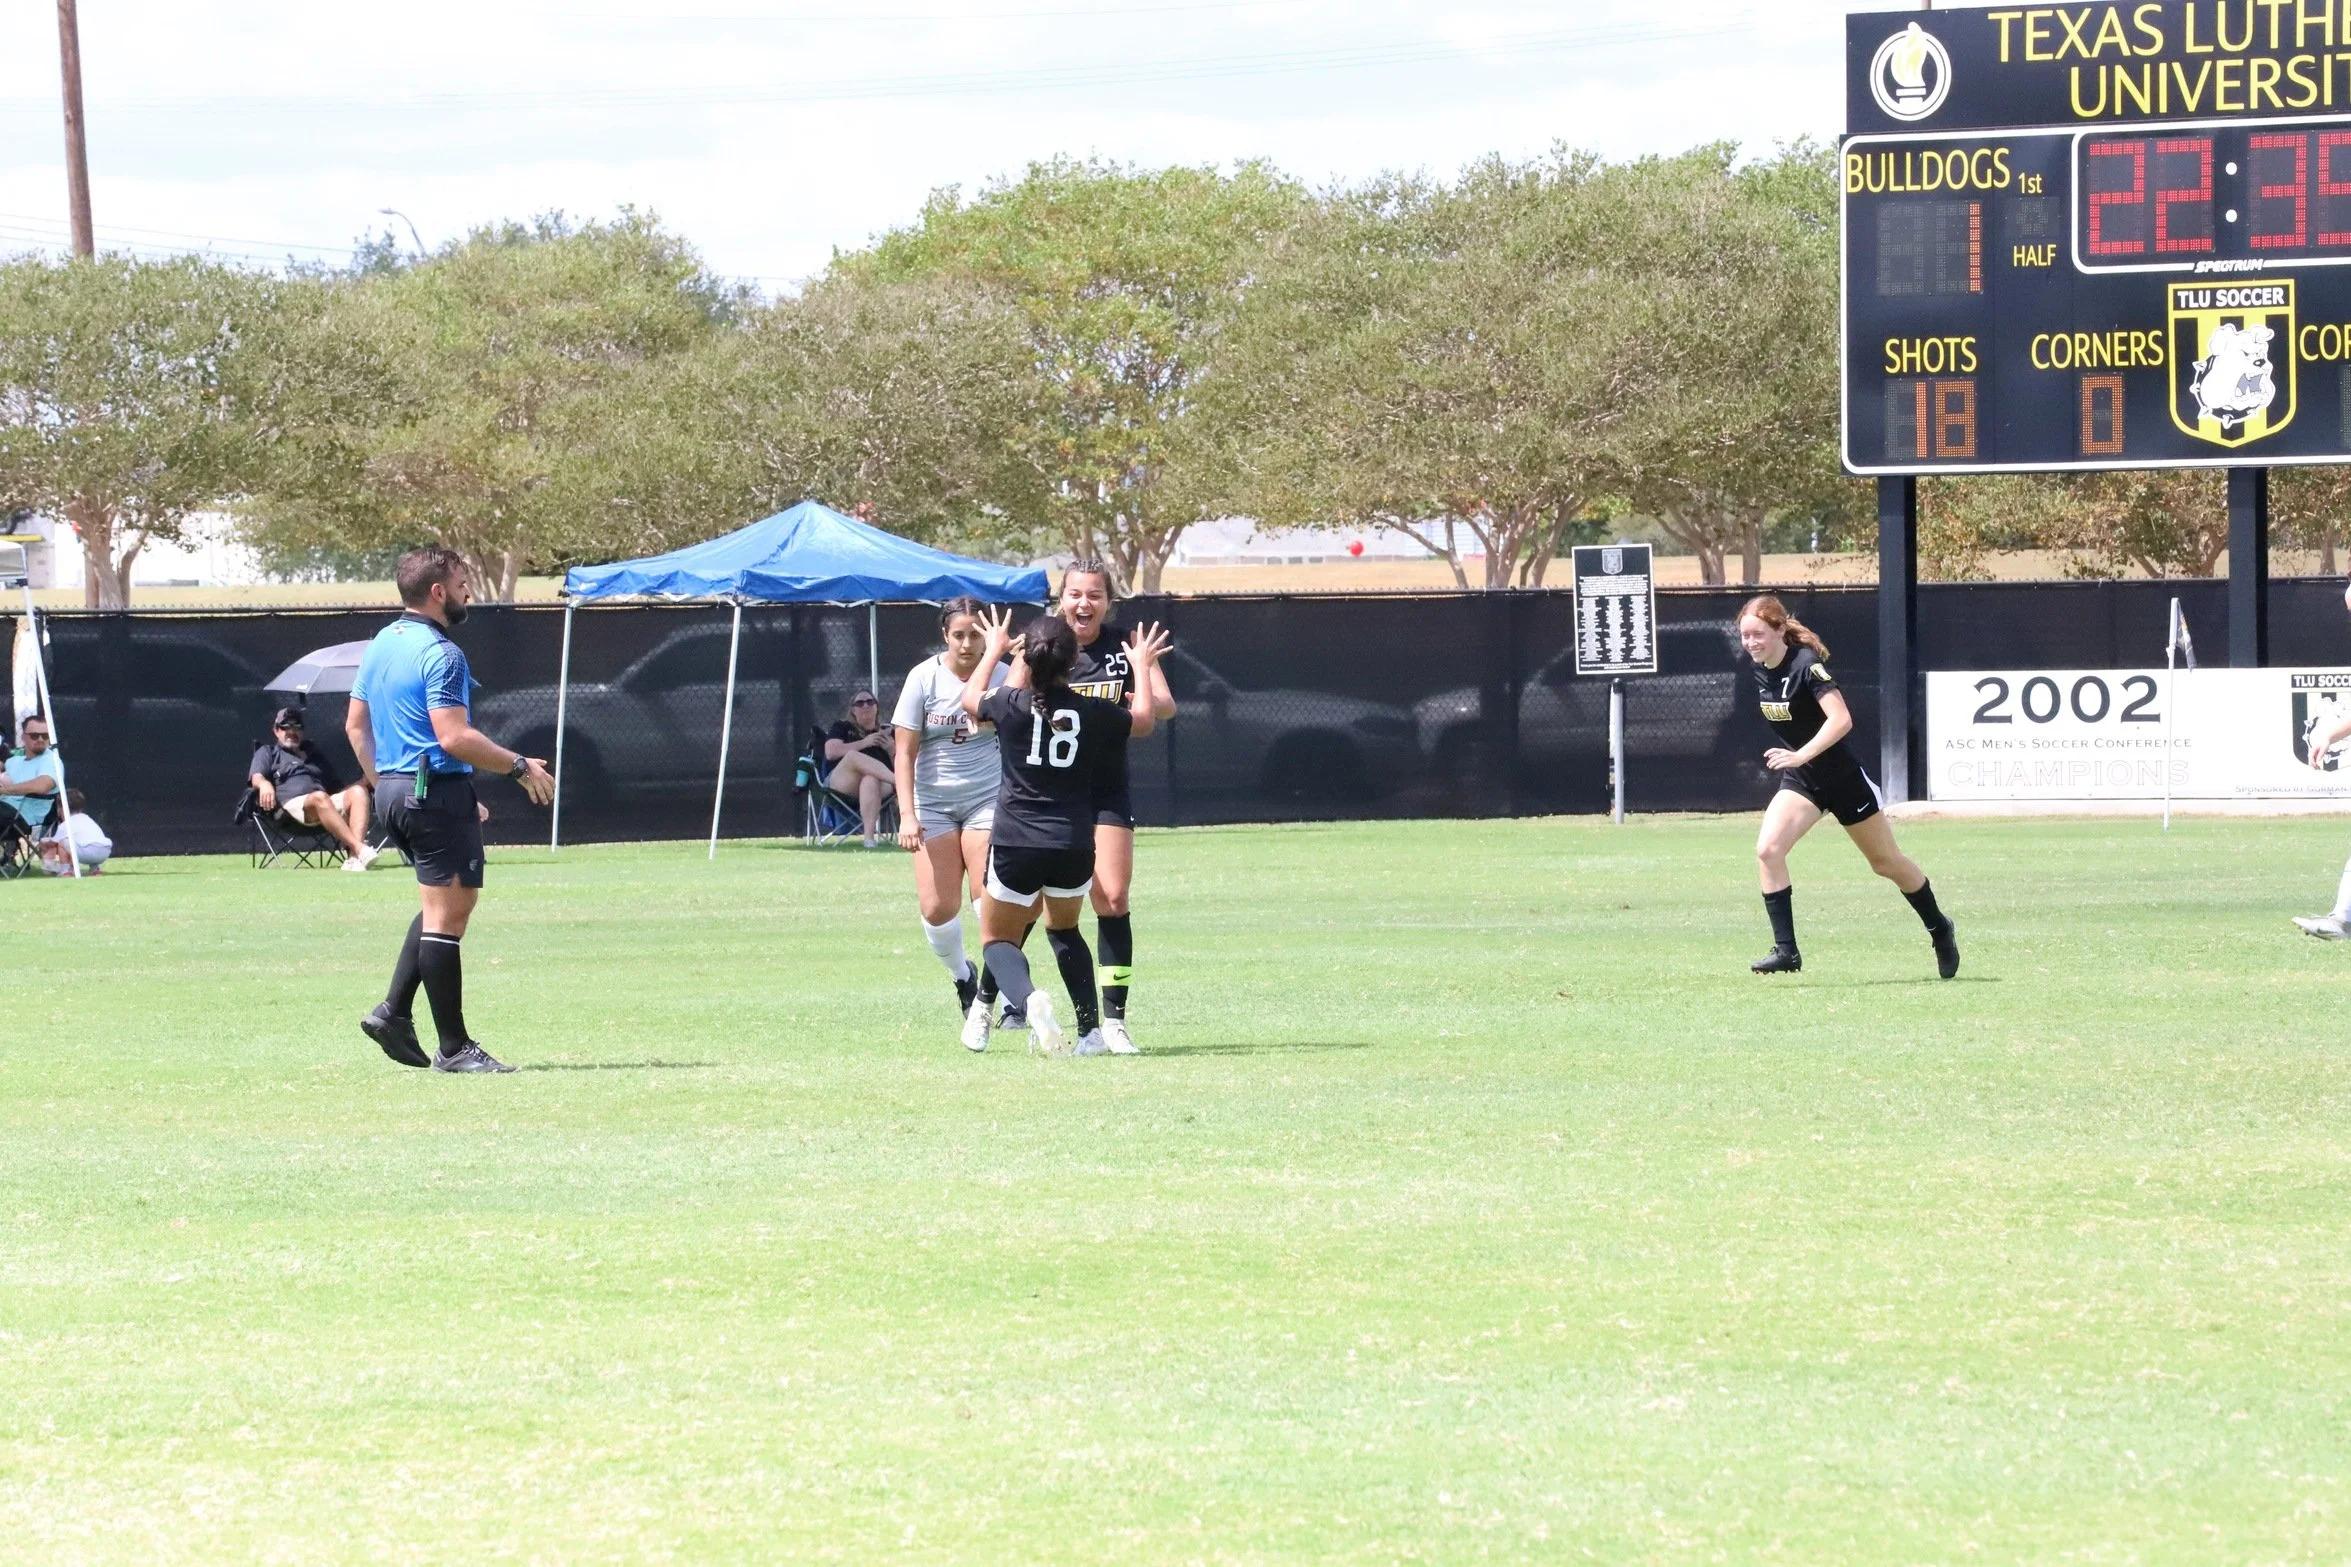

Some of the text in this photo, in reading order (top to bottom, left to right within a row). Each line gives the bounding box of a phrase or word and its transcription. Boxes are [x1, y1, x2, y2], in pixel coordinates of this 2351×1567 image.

[1988, 4, 2164, 63] TEXAS
[1846, 148, 2011, 193] BULLDOGS
[2018, 172, 2043, 194] 1st
[1969, 203, 1981, 292] 1
[2013, 244, 2057, 267] HALF
[2194, 259, 2264, 273] SPECTRUM
[2177, 287, 2285, 308] TLU SOCCER
[1884, 336, 1977, 374] SHOTS
[2031, 330, 2164, 370] CORNERS
[1915, 380, 1975, 458] 18
[2082, 375, 2124, 454] 0
[1105, 652, 1129, 677] 25
[1781, 676, 1790, 699] 7
[2293, 675, 2351, 687] TLU SOCC
[1972, 675, 2162, 725] 2002
[952, 728, 969, 744] 5
[1026, 706, 1081, 768] 18
[1945, 739, 1976, 749] ASC
[1948, 760, 2190, 787] CHAMPIONS
